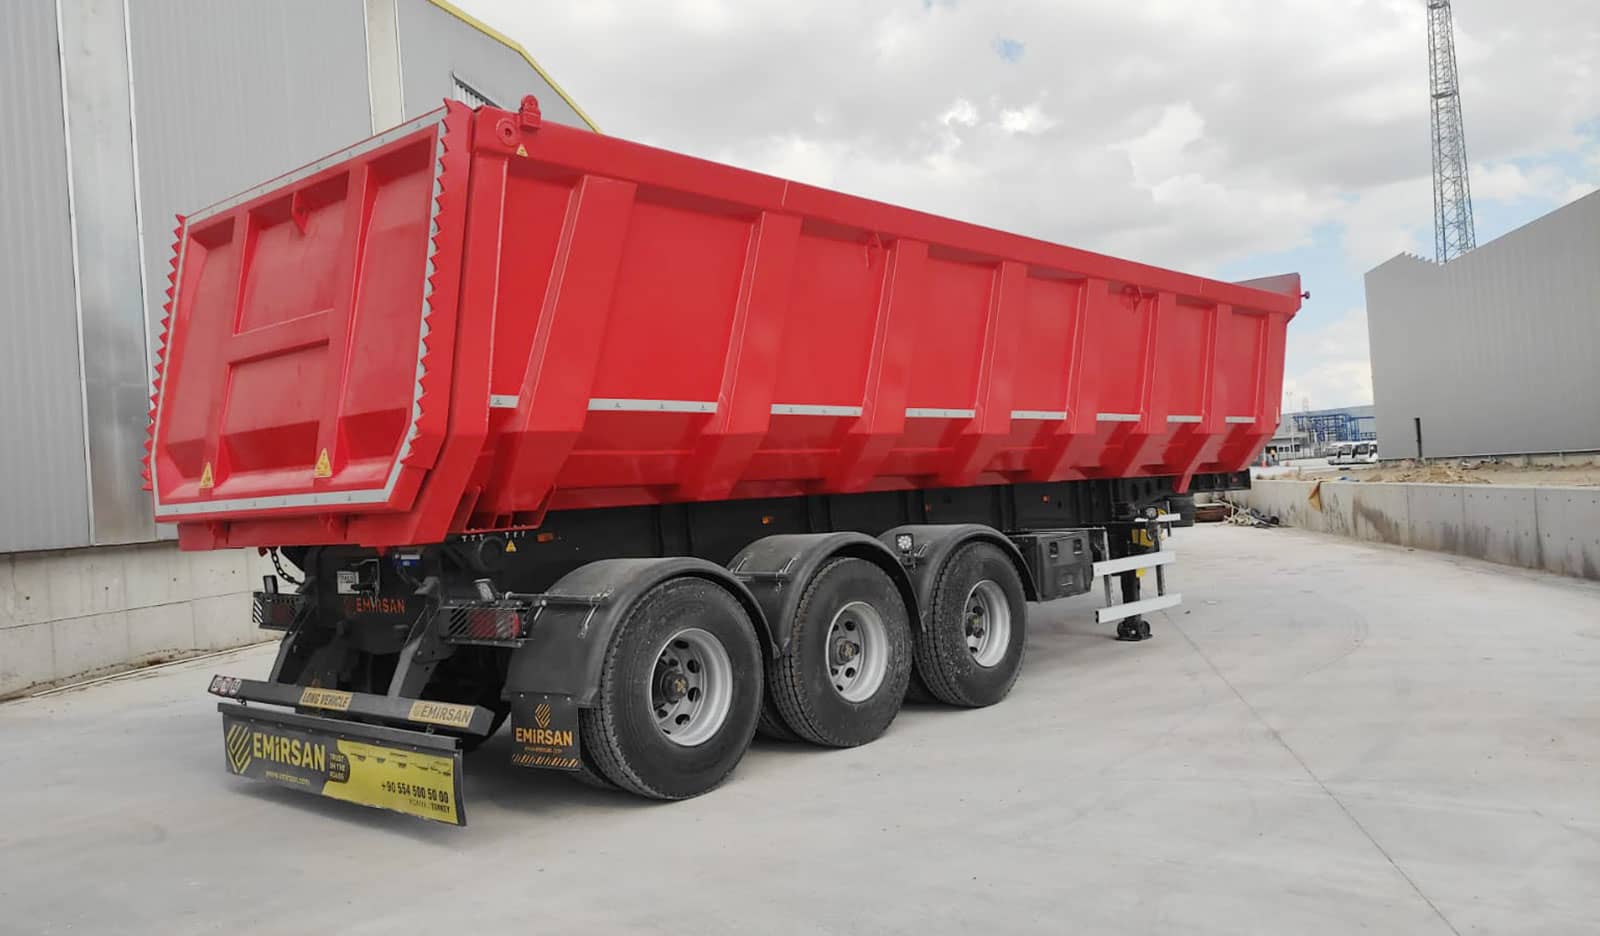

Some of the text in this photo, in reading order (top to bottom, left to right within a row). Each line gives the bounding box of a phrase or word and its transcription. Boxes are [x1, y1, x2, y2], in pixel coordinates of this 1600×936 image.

[302, 689, 350, 708] LONG VEHICLE
[397, 782, 411, 796] 554
[412, 784, 426, 799] 500
[427, 787, 437, 801] 50
[438, 790, 449, 804] 00
